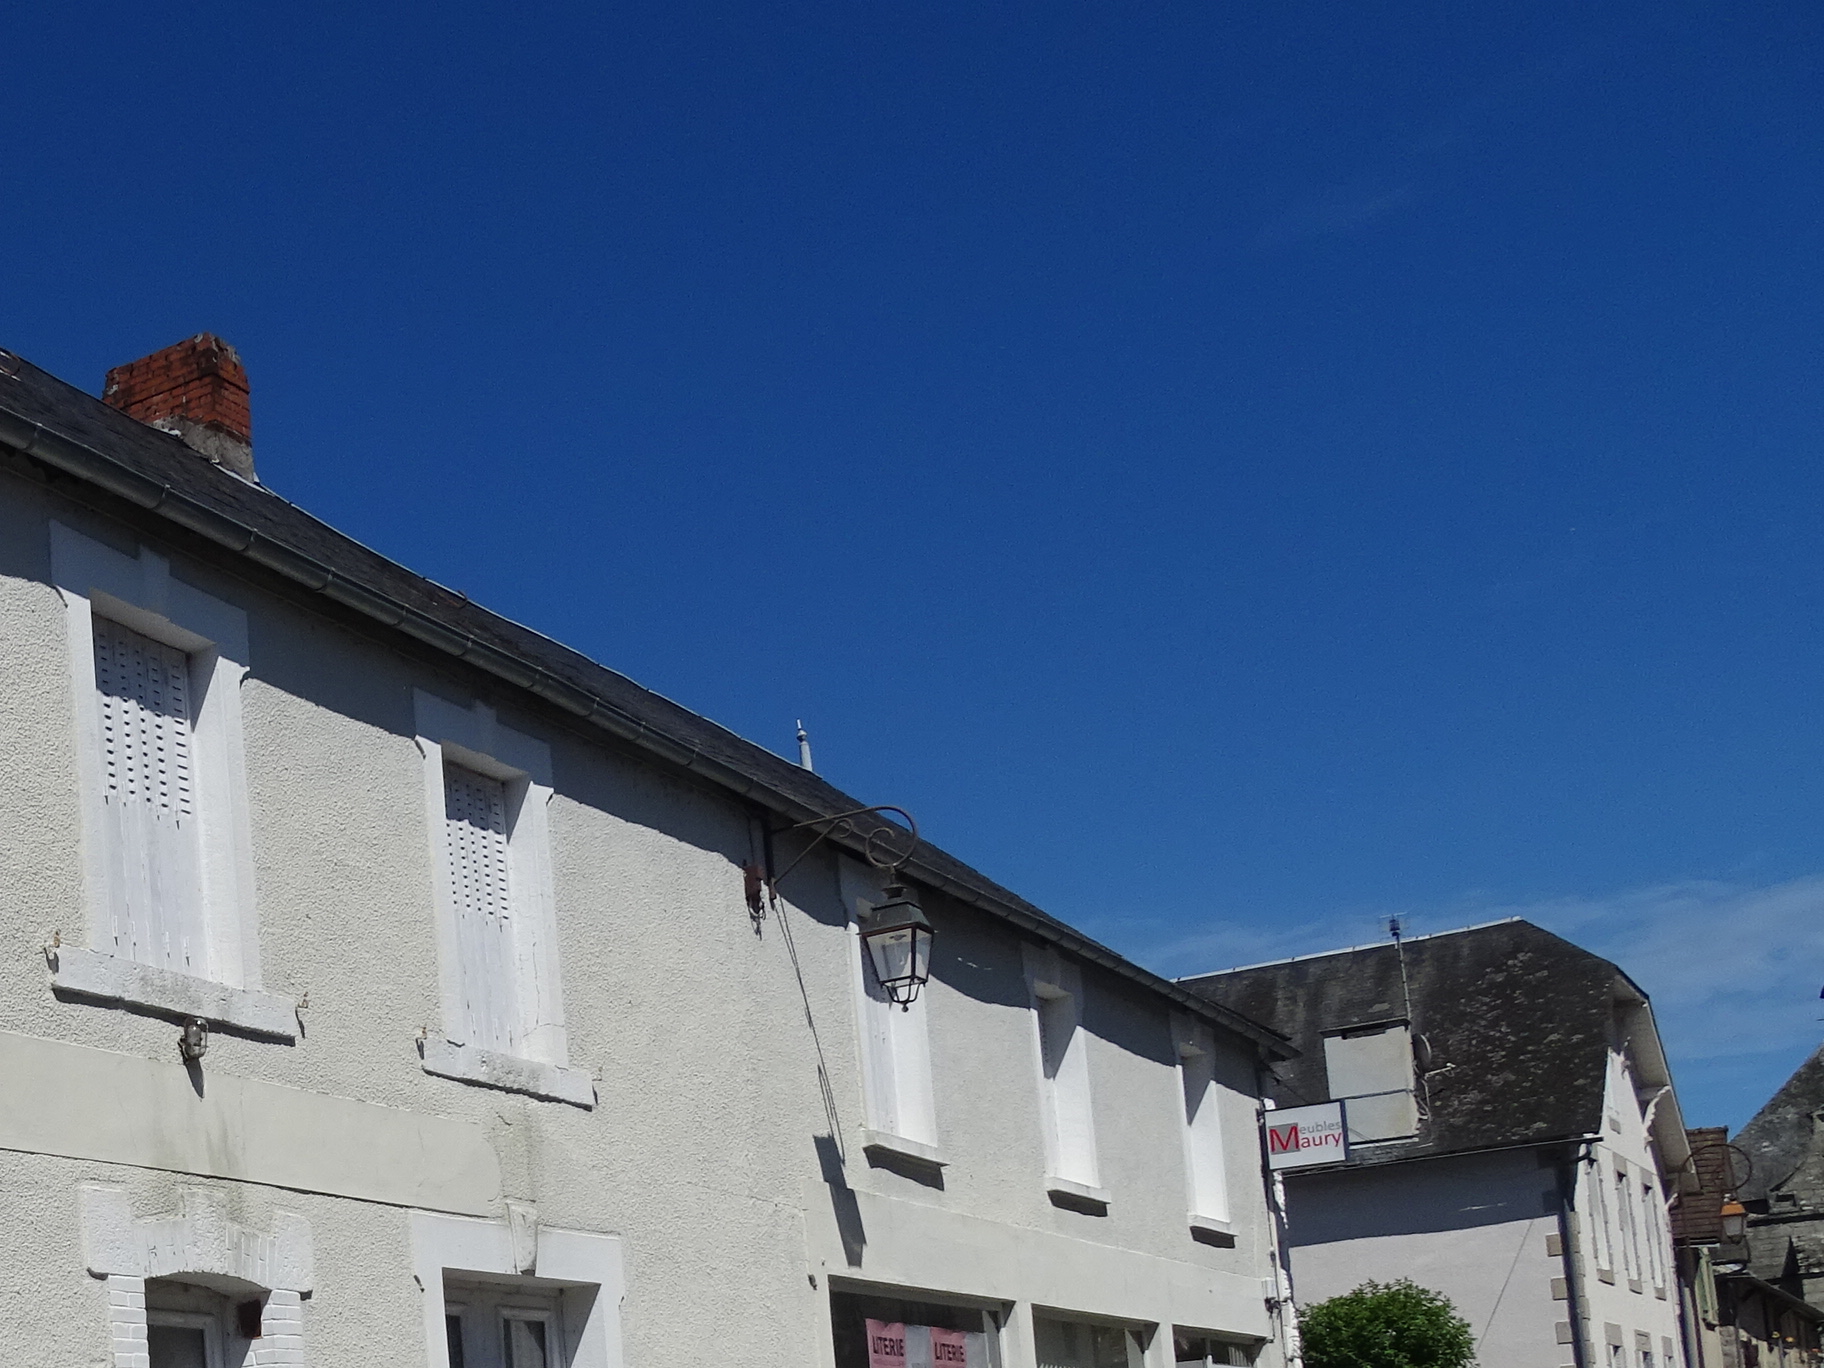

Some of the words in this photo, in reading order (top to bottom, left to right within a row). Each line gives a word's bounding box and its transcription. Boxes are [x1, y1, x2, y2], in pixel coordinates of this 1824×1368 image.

[1269, 1125, 1343, 1152] Maury
[872, 1335, 904, 1357] LITERIE
[934, 1342, 965, 1362] LITERIE
